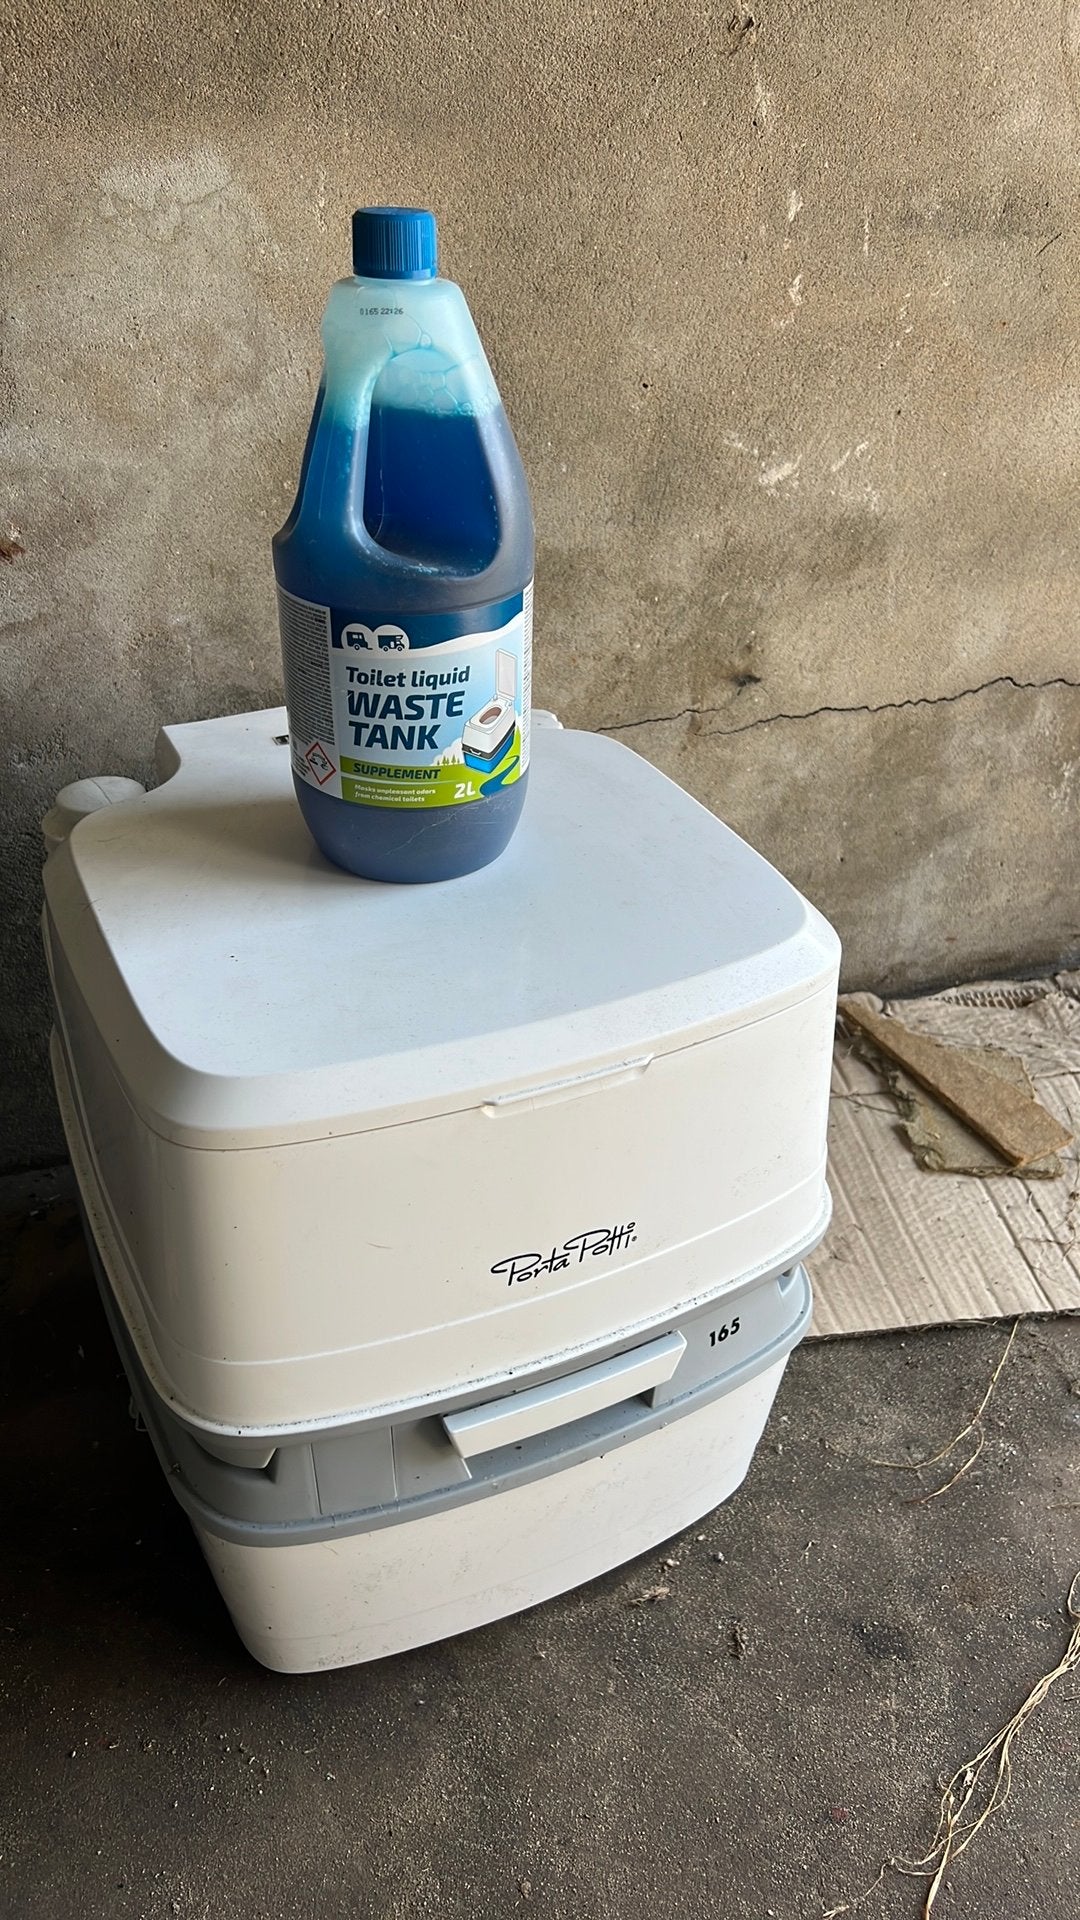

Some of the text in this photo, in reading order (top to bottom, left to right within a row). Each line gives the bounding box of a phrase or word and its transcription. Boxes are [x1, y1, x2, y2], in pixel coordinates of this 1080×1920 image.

[346, 665, 470, 690] Toilet liquid
[347, 690, 465, 720] WASTE
[348, 721, 441, 750] TANK
[353, 763, 441, 779] SUPPLEMENT
[354, 784, 376, 793] Masks
[376, 786, 416, 796] unpleasant
[354, 791, 426, 803] from chemical toilets
[453, 781, 476, 799] 2L
[490, 1248, 570, 1286] Porta
[708, 1316, 741, 1348] 165
